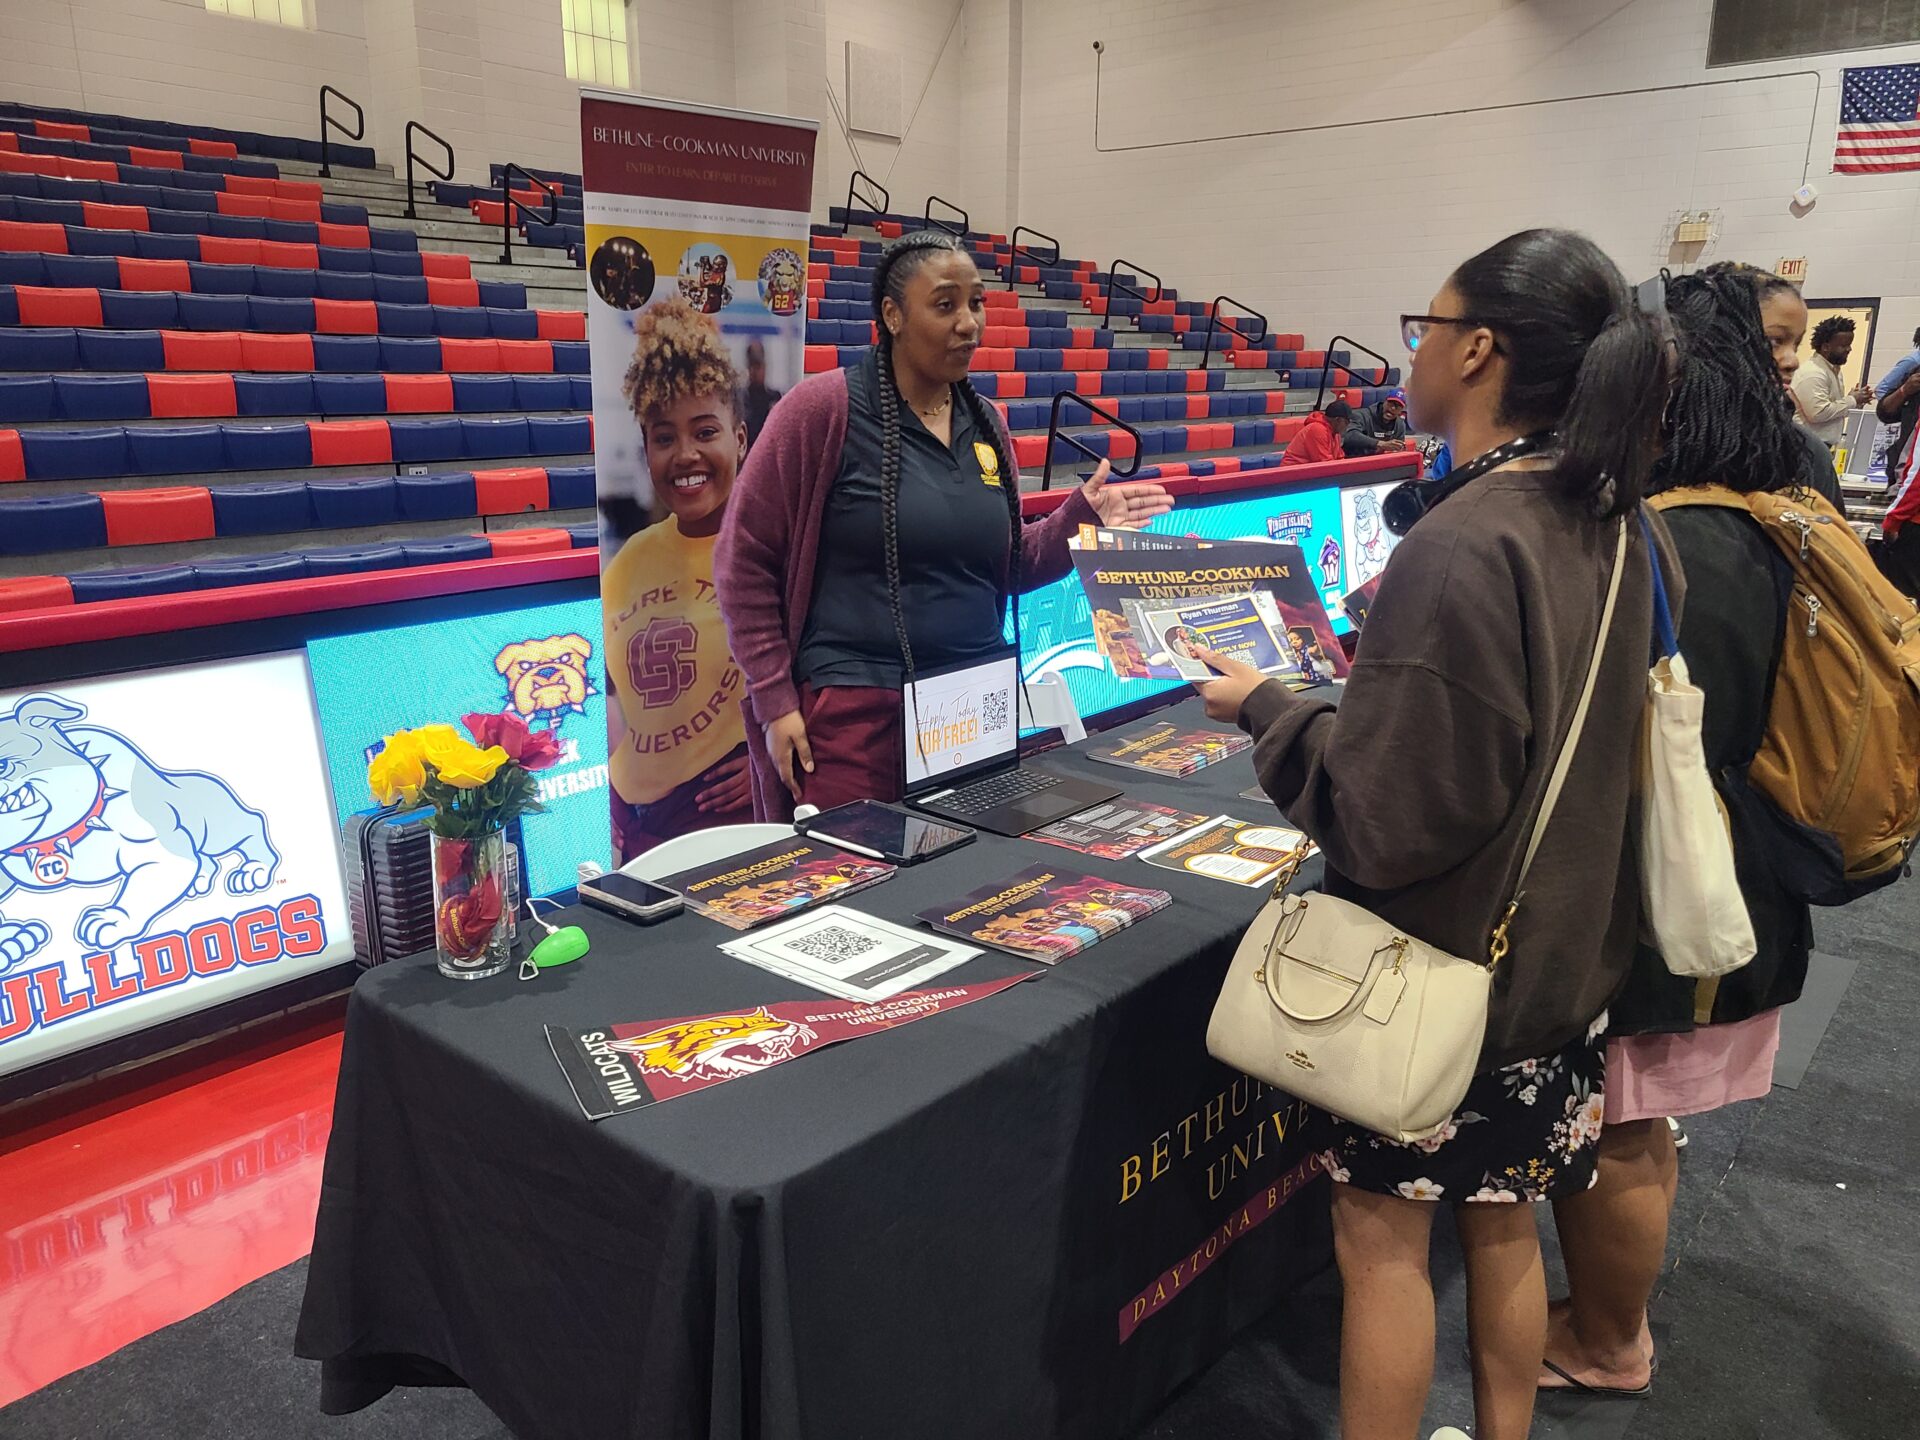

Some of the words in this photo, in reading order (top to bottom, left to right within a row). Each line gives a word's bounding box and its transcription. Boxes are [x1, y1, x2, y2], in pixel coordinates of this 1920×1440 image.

[593, 127, 738, 158] BETHUNE-COOKMAN
[741, 145, 808, 167] UNIVERSITY
[1781, 260, 1803, 275] EXIT
[773, 295, 789, 308] 62
[1267, 518, 1287, 535] VIRGIN
[1288, 512, 1312, 529] ISLANDS
[1096, 565, 1290, 585] BETHUNE-COOKMAN
[1139, 581, 1256, 599] UNIVERSITY
[1181, 610, 1202, 620] Ryan
[1202, 603, 1239, 616] Thurman
[1238, 640, 1257, 650] NOW
[944, 718, 978, 749] FREE!
[39, 859, 63, 877] TC
[688, 847, 813, 892] BETHUNE-COOKMAN
[723, 859, 796, 886] UNIVERSITY
[947, 873, 1055, 922] BETHUNE-COOKMAN
[979, 886, 1041, 916] UNIVERSITY
[806, 987, 968, 1024] BETHUNE-COOKMAN
[845, 1000, 942, 1026] UNIVERSITY
[581, 1031, 642, 1108] WILDCATS
[1133, 1207, 1250, 1323] DAYTONA
